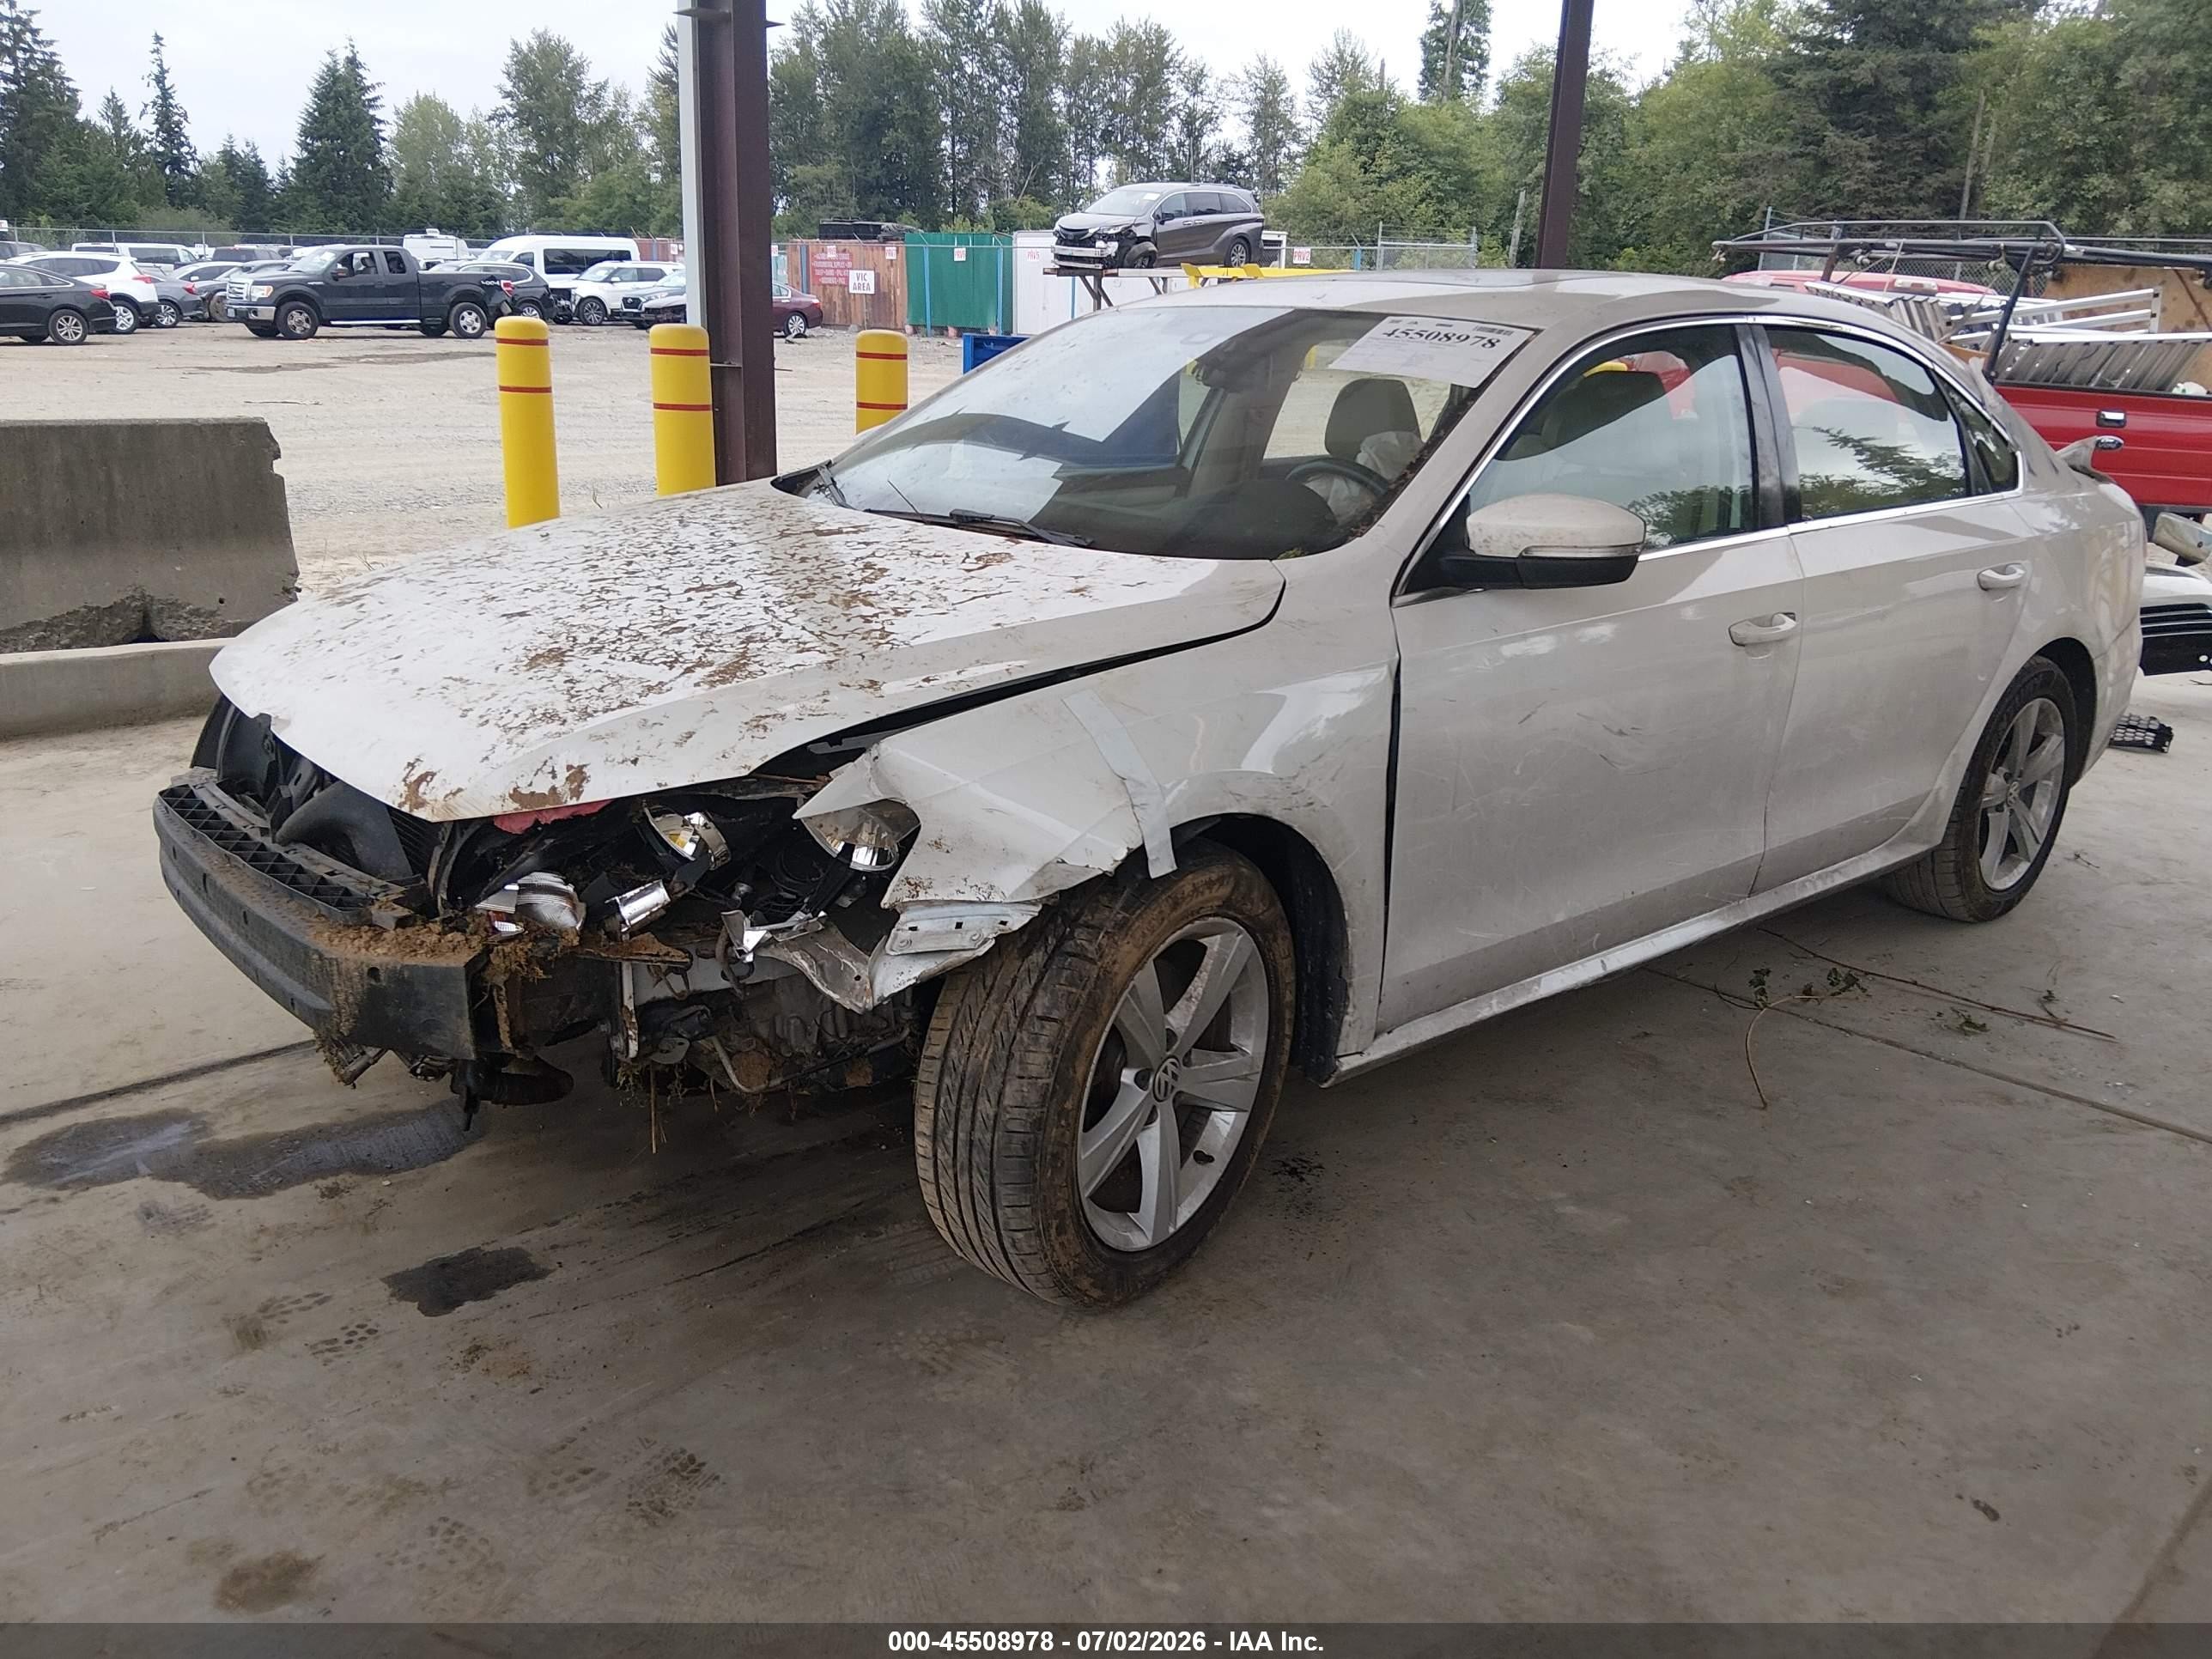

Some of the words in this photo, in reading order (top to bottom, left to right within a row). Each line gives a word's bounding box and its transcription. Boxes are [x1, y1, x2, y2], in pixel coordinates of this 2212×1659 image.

[1293, 251, 1310, 261] PRV2
[855, 272, 867, 282] VIC
[852, 282, 871, 292] AREA
[1382, 327, 1501, 349] 45508978
